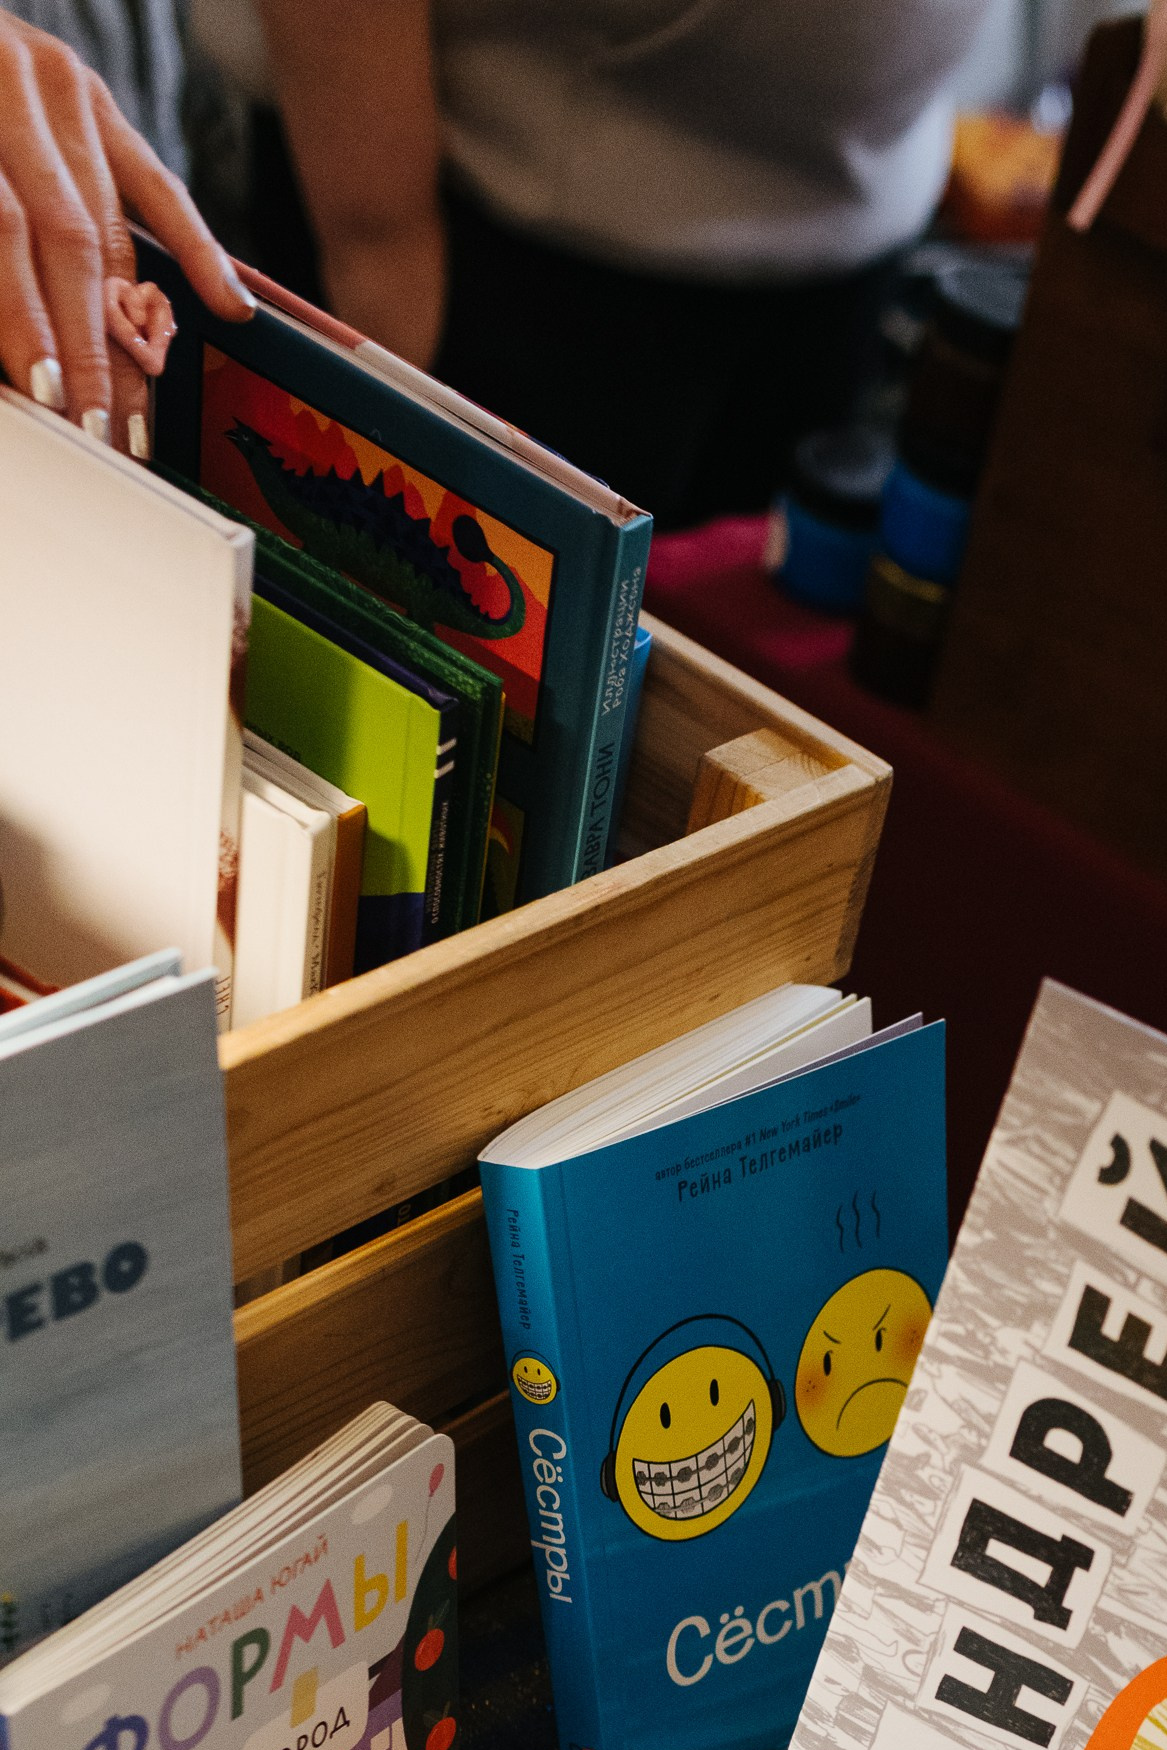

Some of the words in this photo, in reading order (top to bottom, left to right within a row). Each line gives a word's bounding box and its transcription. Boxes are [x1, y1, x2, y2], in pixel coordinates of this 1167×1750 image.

[591, 742, 615, 812] ТОНИ
[655, 1163, 682, 1181] автор
[684, 1140, 742, 1170] бестселлера
[744, 1131, 757, 1148] #1
[759, 1126, 778, 1142] New
[781, 1114, 801, 1133] York
[677, 1168, 732, 1202] Рейна
[739, 1123, 843, 1179] Телгемайер
[506, 1209, 520, 1249] Рейна
[512, 1253, 531, 1330] Телгемайер
[528, 1428, 573, 1604] Сёстры
[175, 1587, 265, 1660] НАТАША
[270, 1533, 329, 1594] ЮГАЙ
[666, 1559, 851, 1687] Сёст
